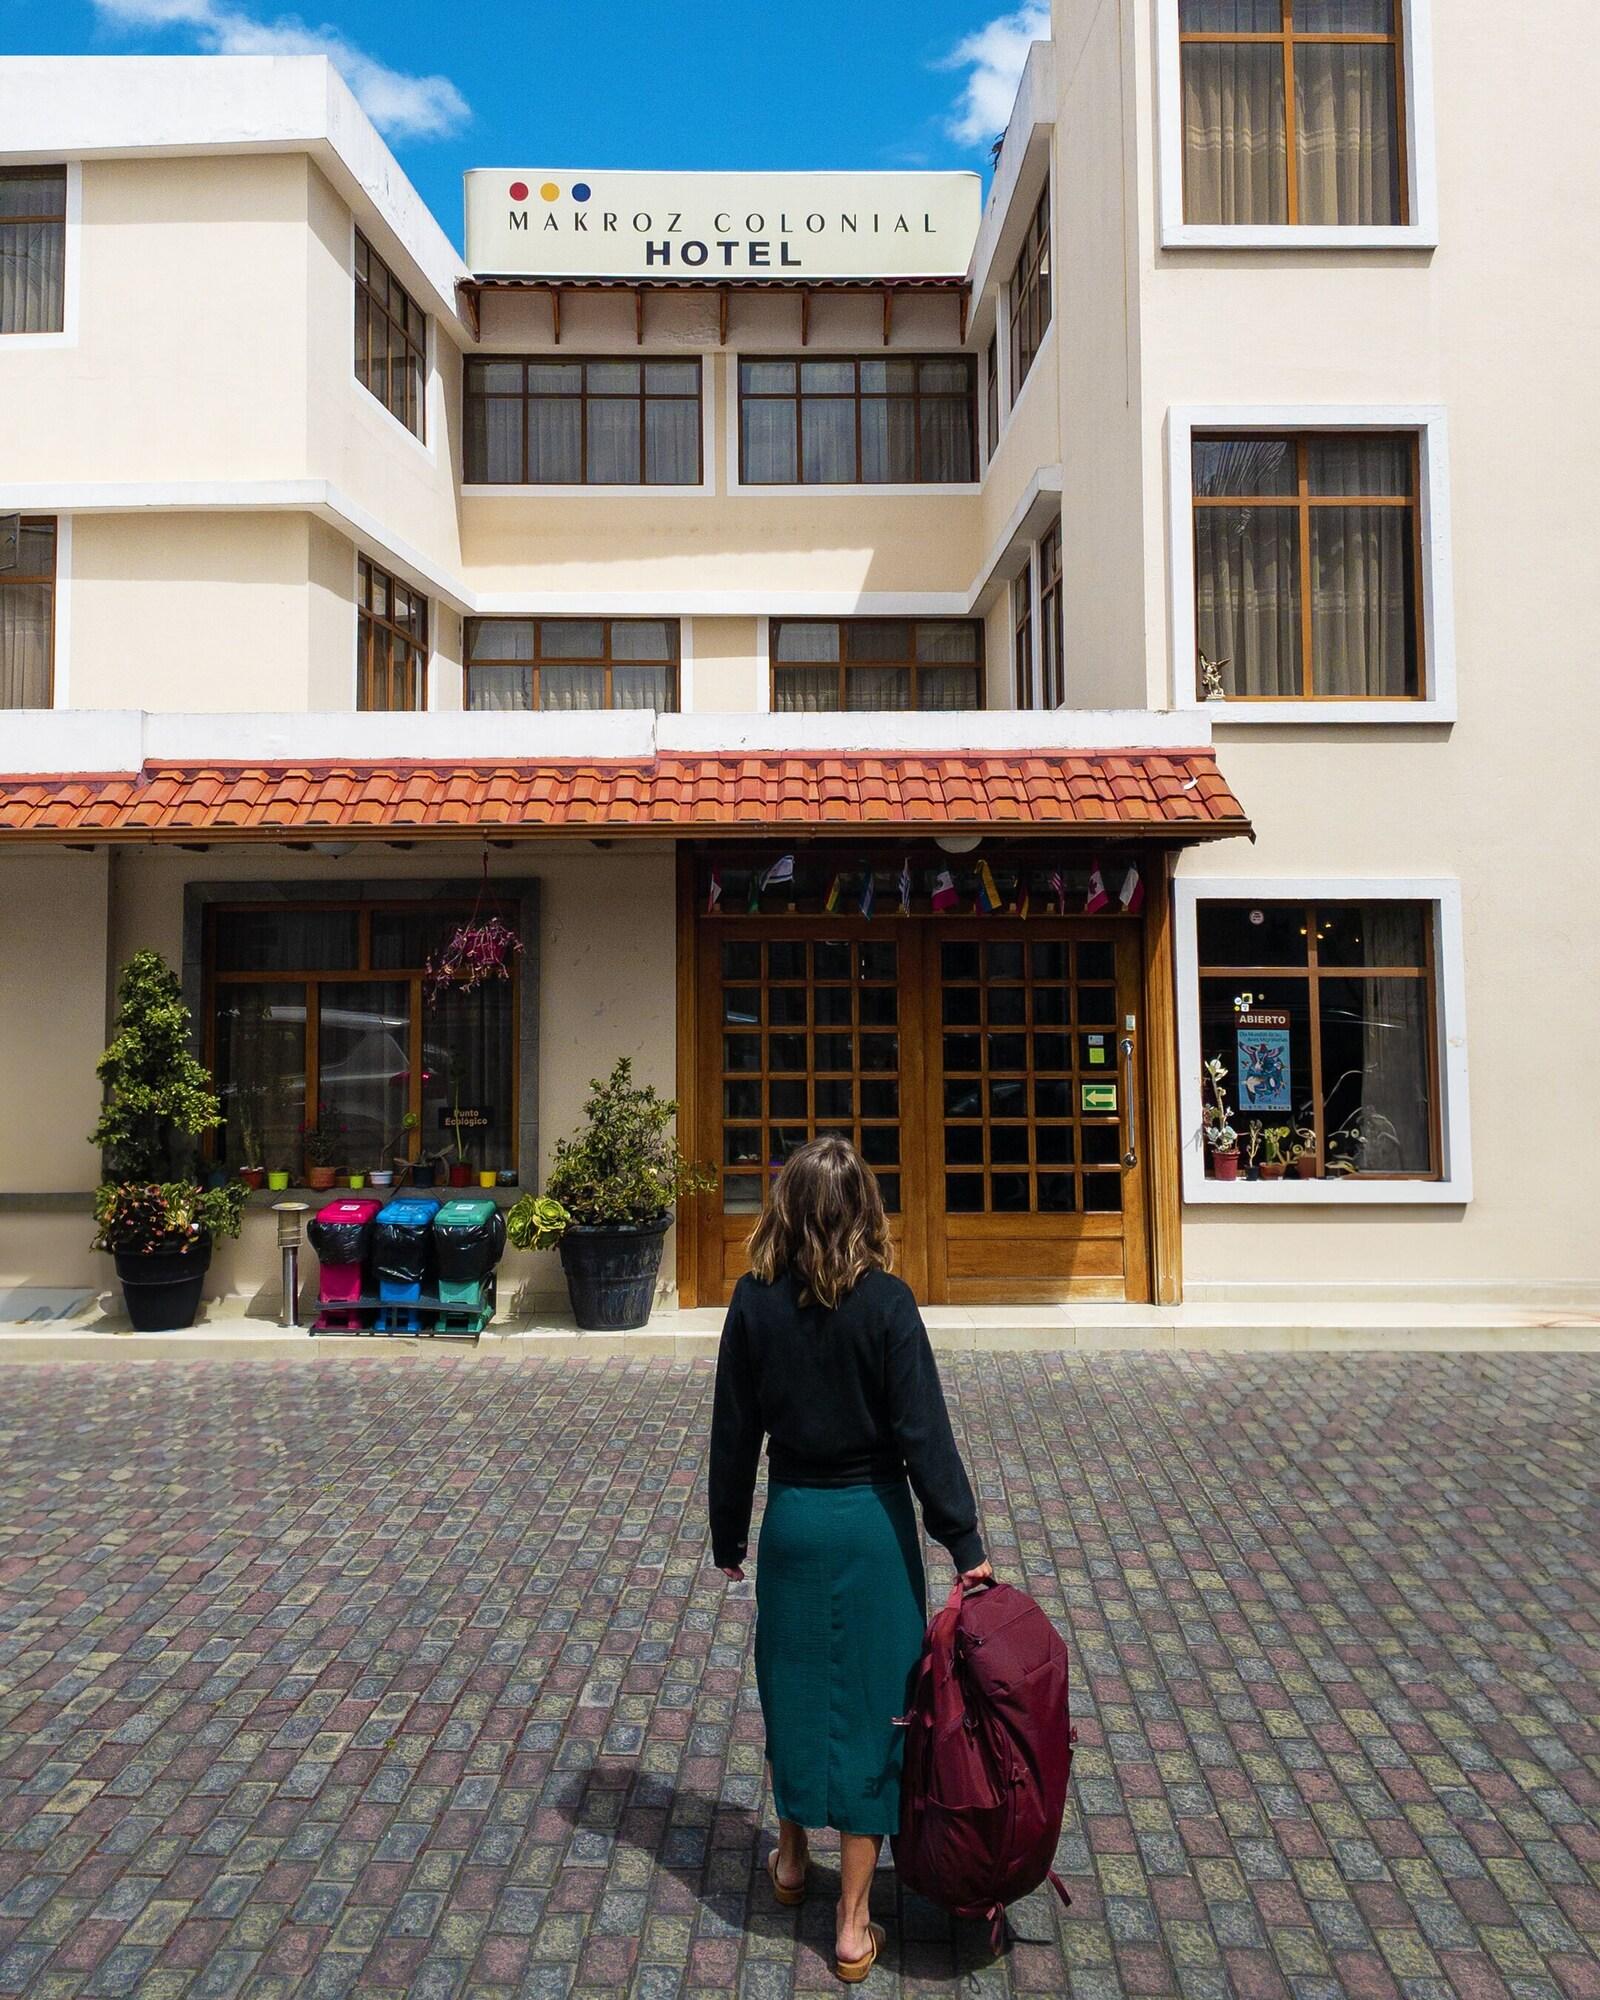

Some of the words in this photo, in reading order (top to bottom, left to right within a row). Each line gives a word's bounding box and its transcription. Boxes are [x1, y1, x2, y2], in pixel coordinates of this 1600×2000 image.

[509, 211, 683, 232] MAKROZ
[714, 213, 937, 234] COLONIAL
[646, 240, 802, 266] HOTEL
[1239, 1015, 1286, 1024] ABIERTO
[453, 1109, 479, 1117] Punto
